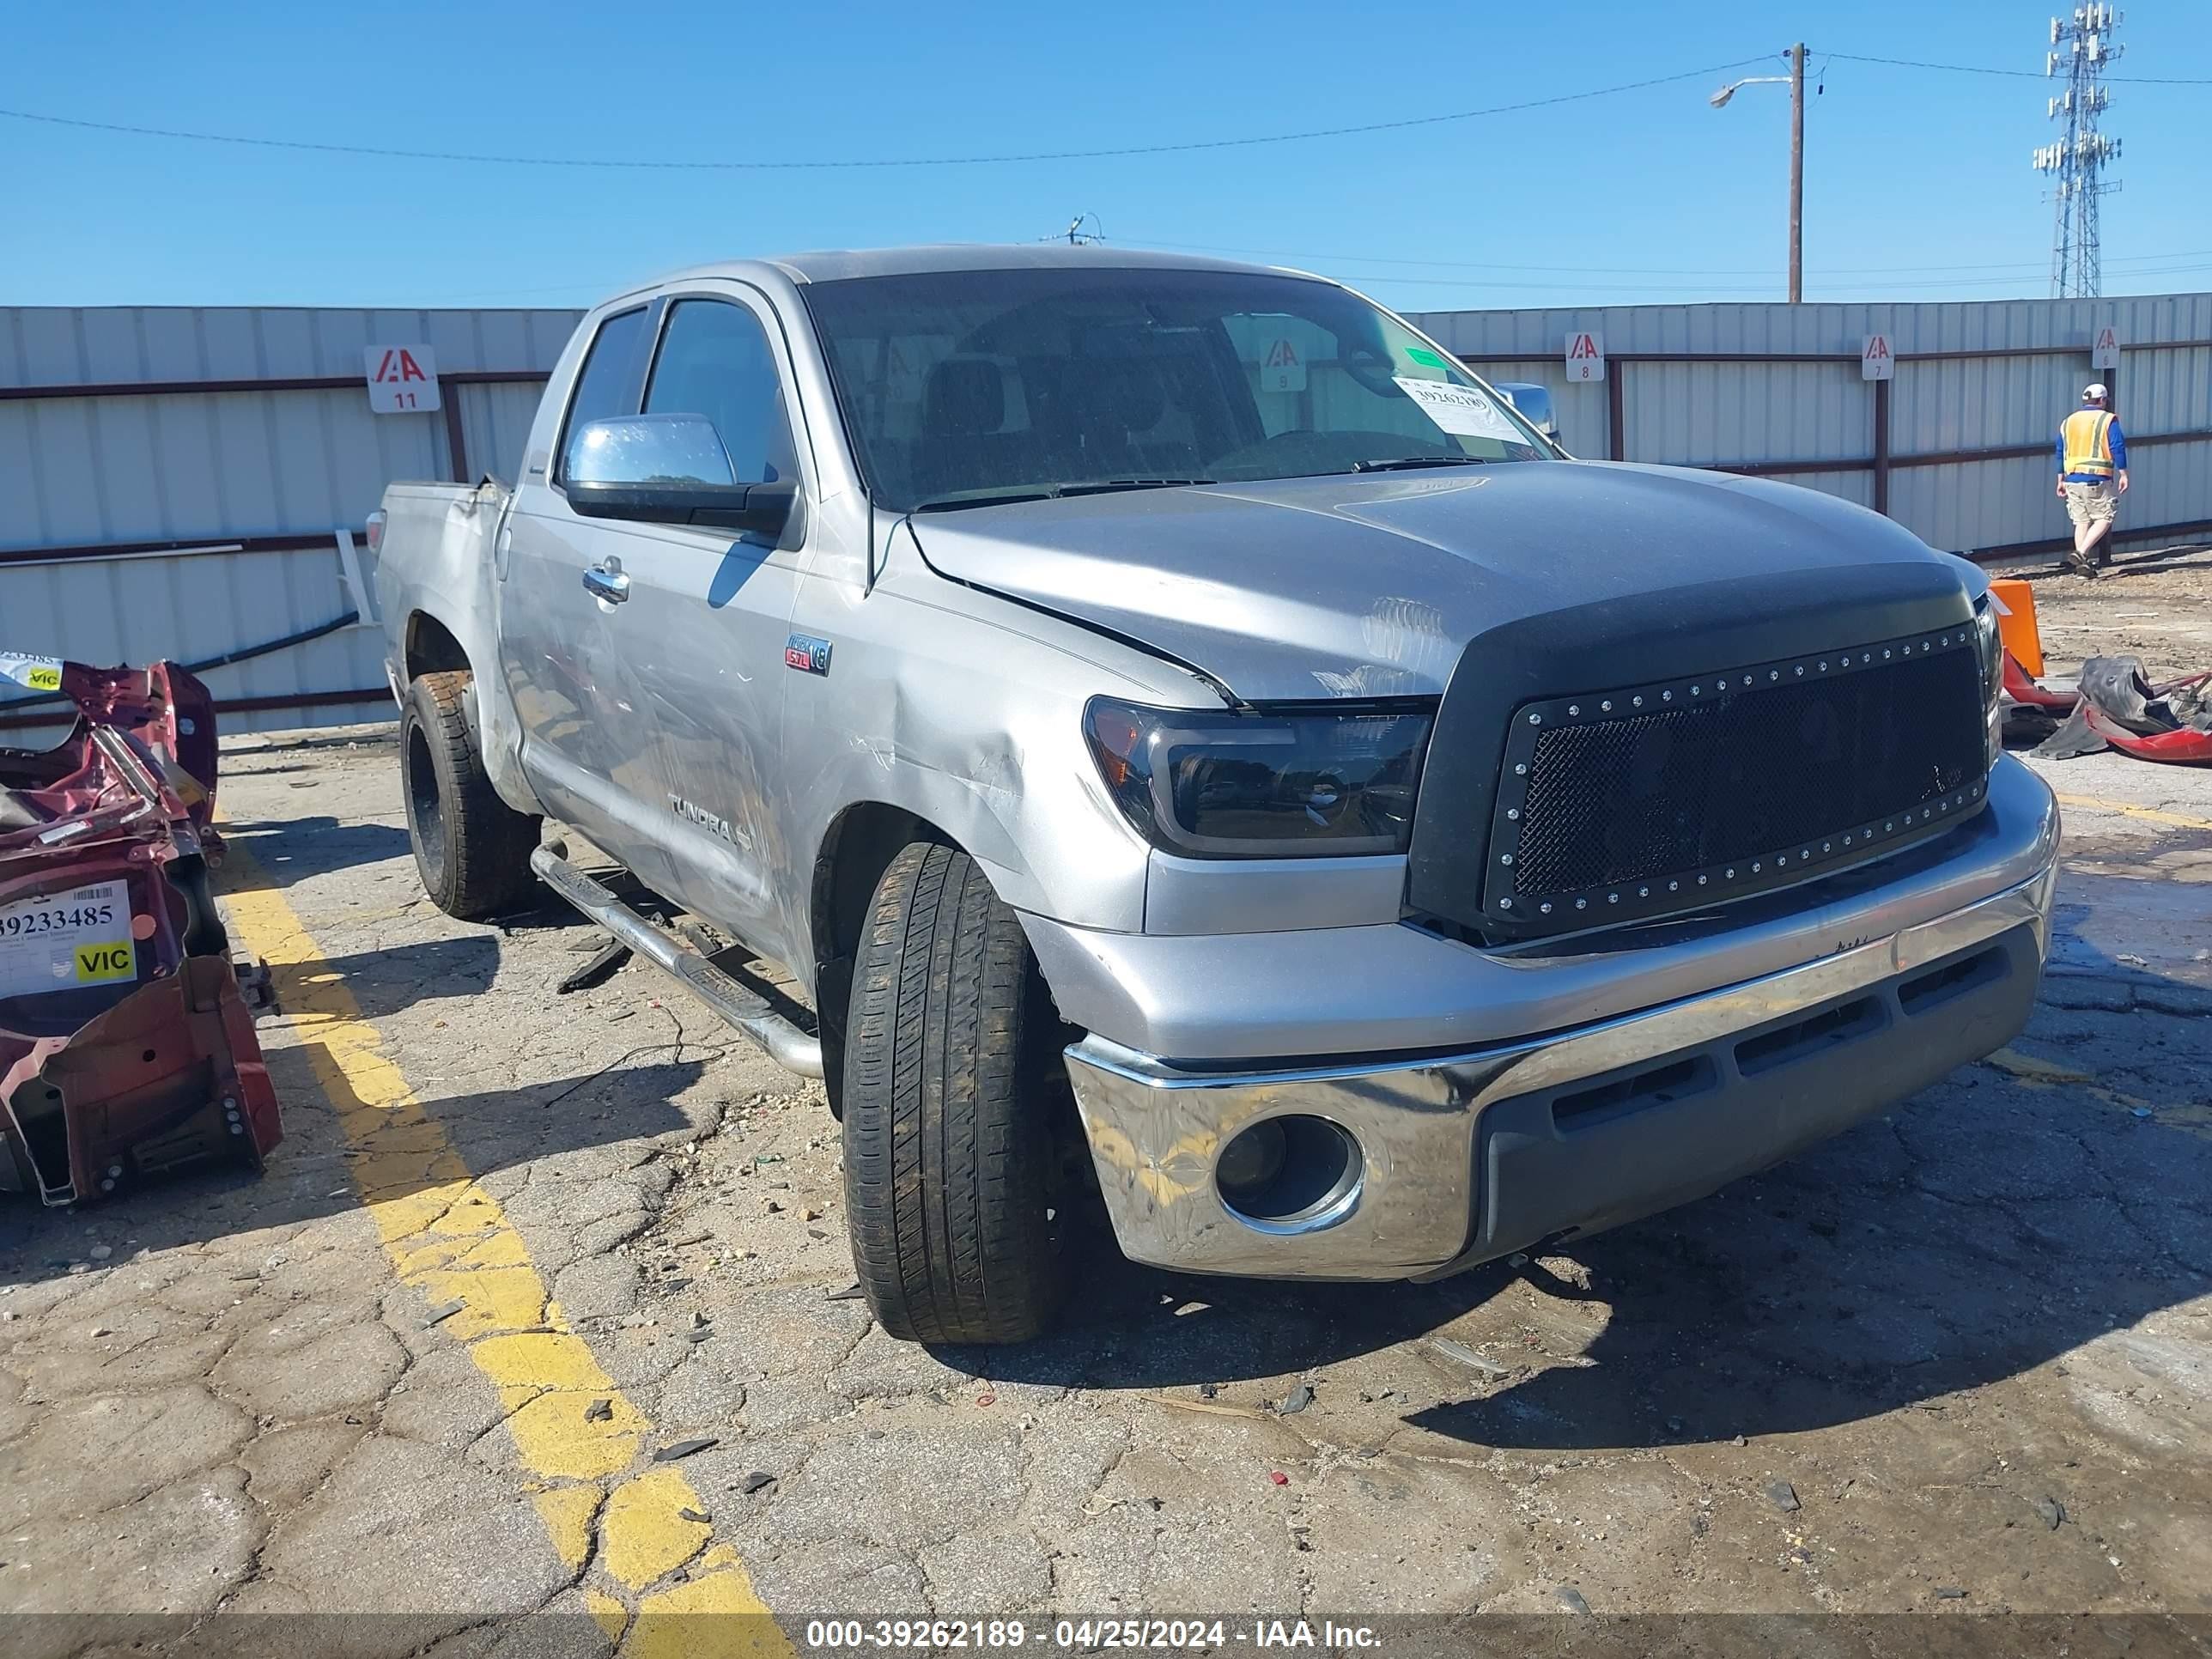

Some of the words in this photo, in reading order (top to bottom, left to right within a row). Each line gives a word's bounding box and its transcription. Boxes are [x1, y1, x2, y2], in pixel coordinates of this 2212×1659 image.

[1582, 366, 1589, 379] 8
[1875, 366, 1881, 377] 7
[395, 392, 416, 409] 11
[1415, 389, 1487, 410] 39262189
[31, 672, 58, 685] VIC
[667, 793, 732, 843] TUNDRA
[81, 949, 129, 972] VIC
